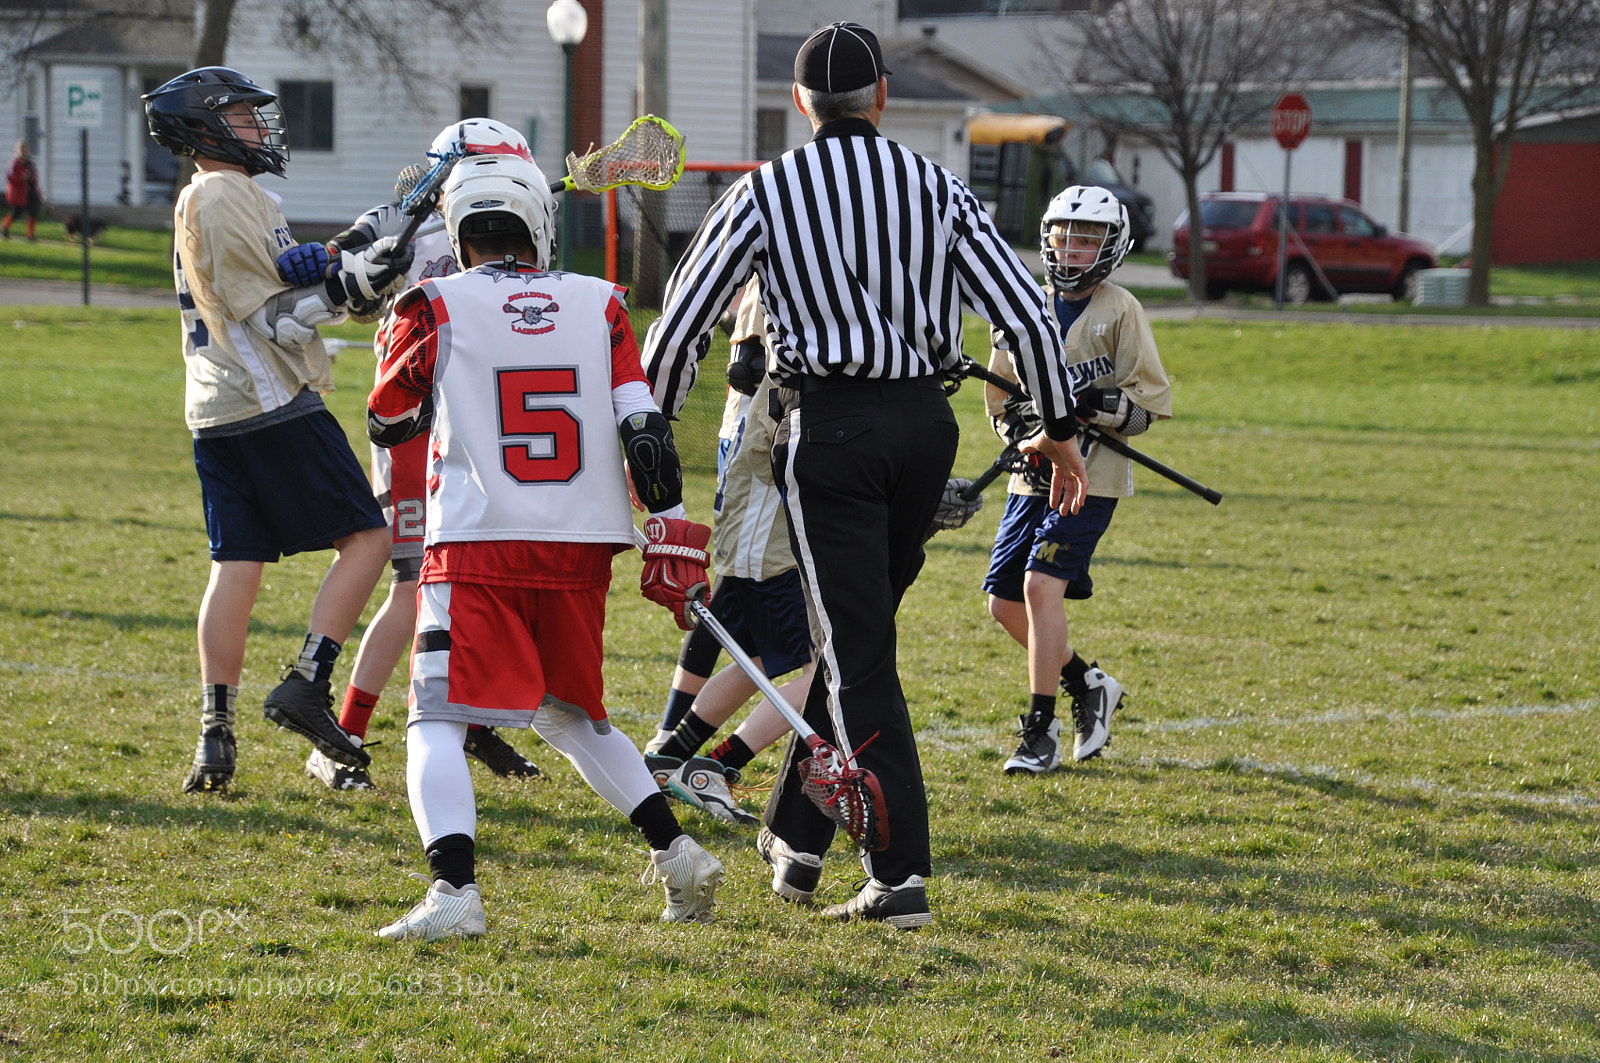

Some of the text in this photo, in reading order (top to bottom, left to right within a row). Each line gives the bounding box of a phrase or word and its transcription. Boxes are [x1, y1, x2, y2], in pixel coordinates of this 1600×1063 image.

[1274, 109, 1310, 134] STOP
[493, 364, 585, 486] 5
[397, 498, 425, 537] 2
[646, 543, 707, 562] WARRIOR
